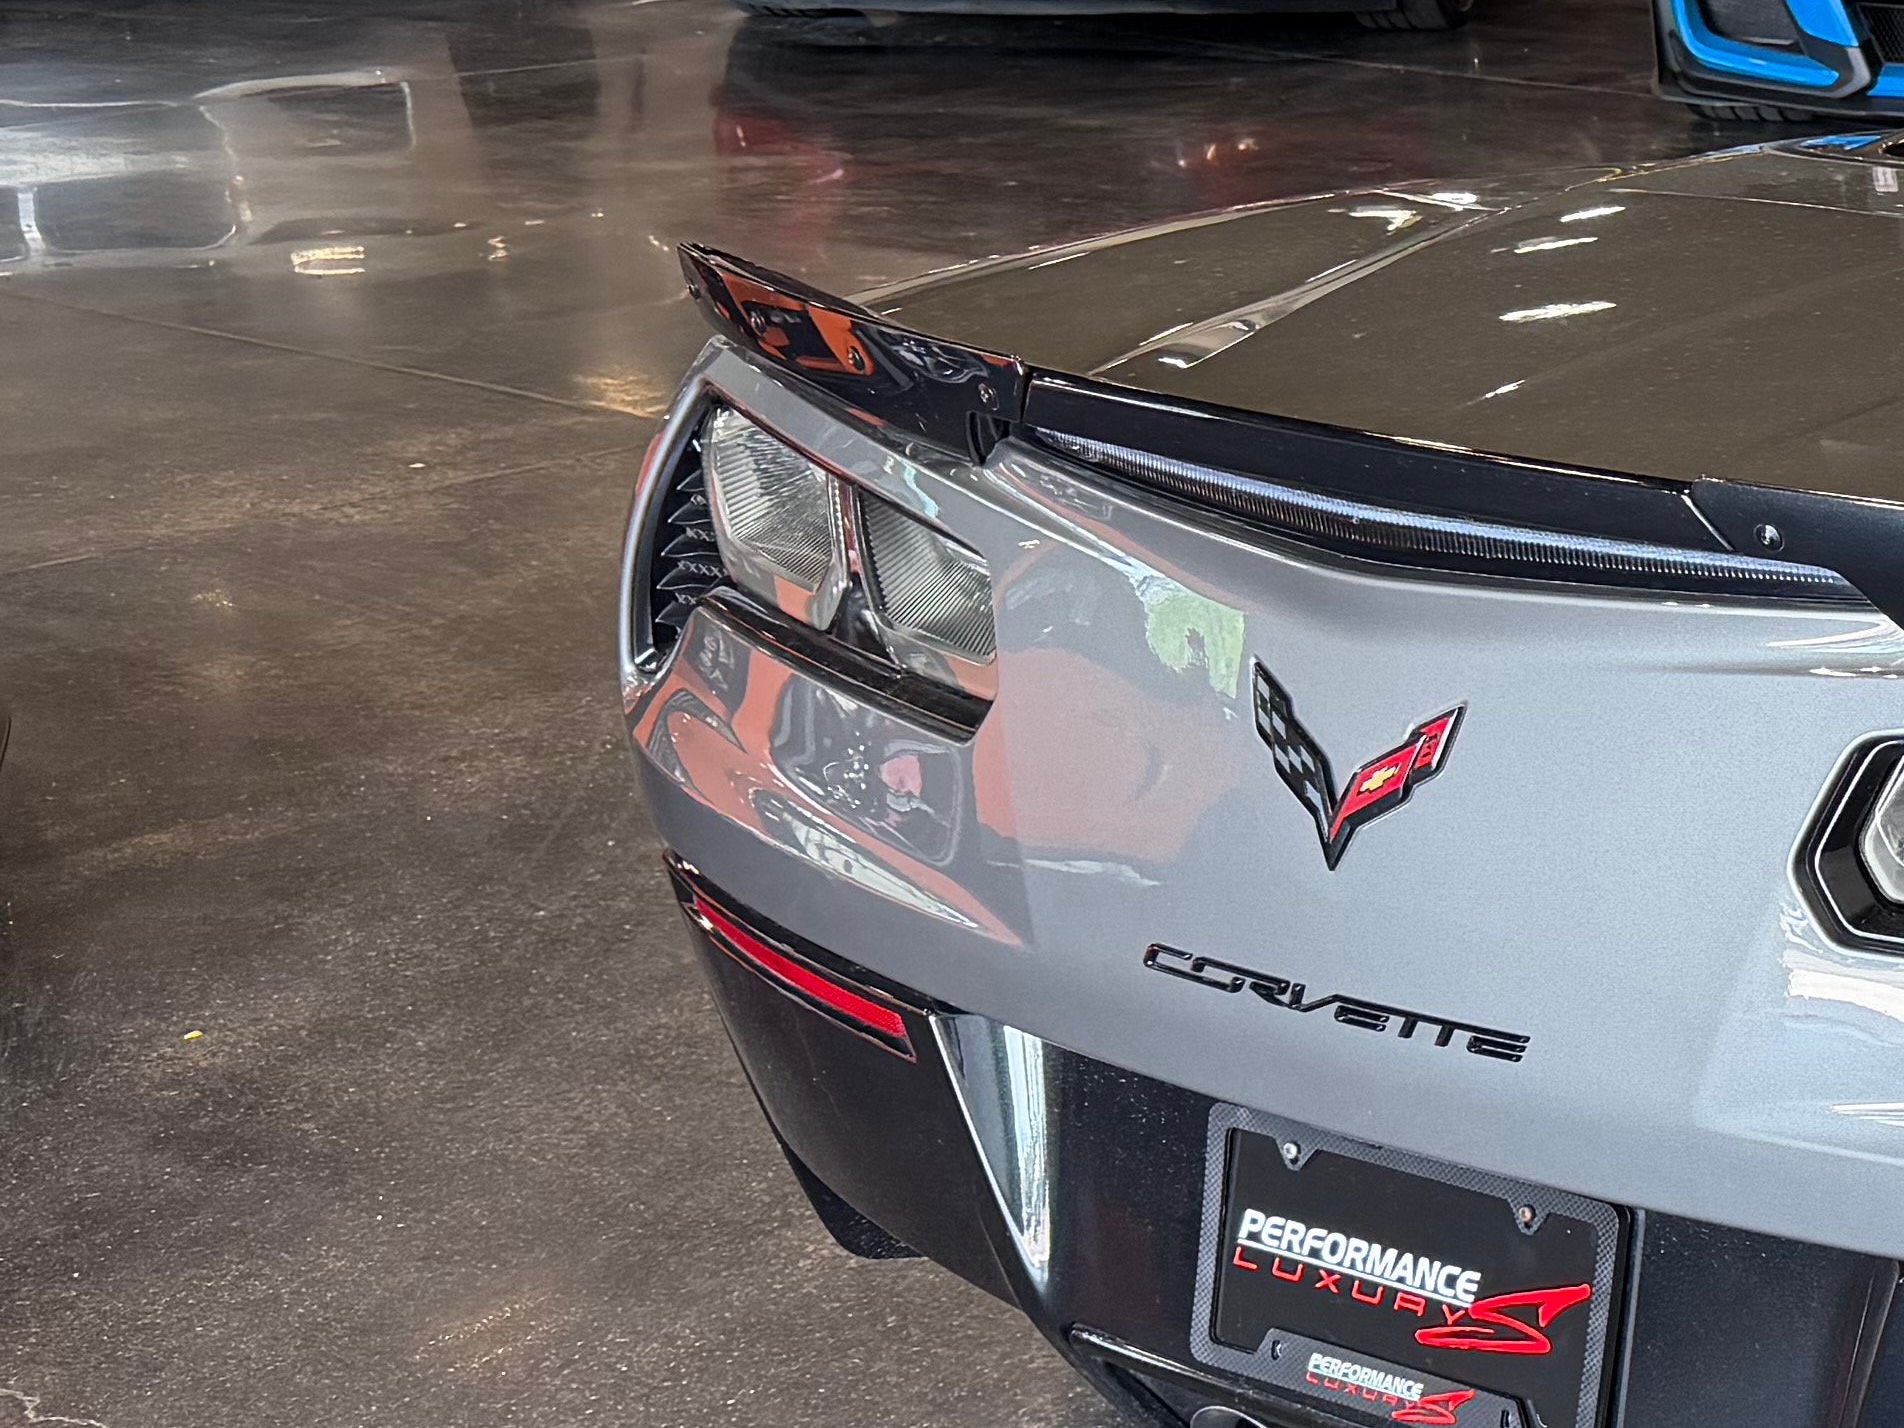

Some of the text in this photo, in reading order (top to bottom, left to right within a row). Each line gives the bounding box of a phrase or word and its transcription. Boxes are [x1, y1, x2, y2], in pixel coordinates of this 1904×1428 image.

[1143, 942, 1531, 1063] CORVETTE
[1232, 1246, 1466, 1326] LUXURY
[1239, 1208, 1482, 1304] PERFORMANCE
[1305, 1372, 1417, 1411] LUXURY
[1308, 1352, 1424, 1399] PERFORMANCE
